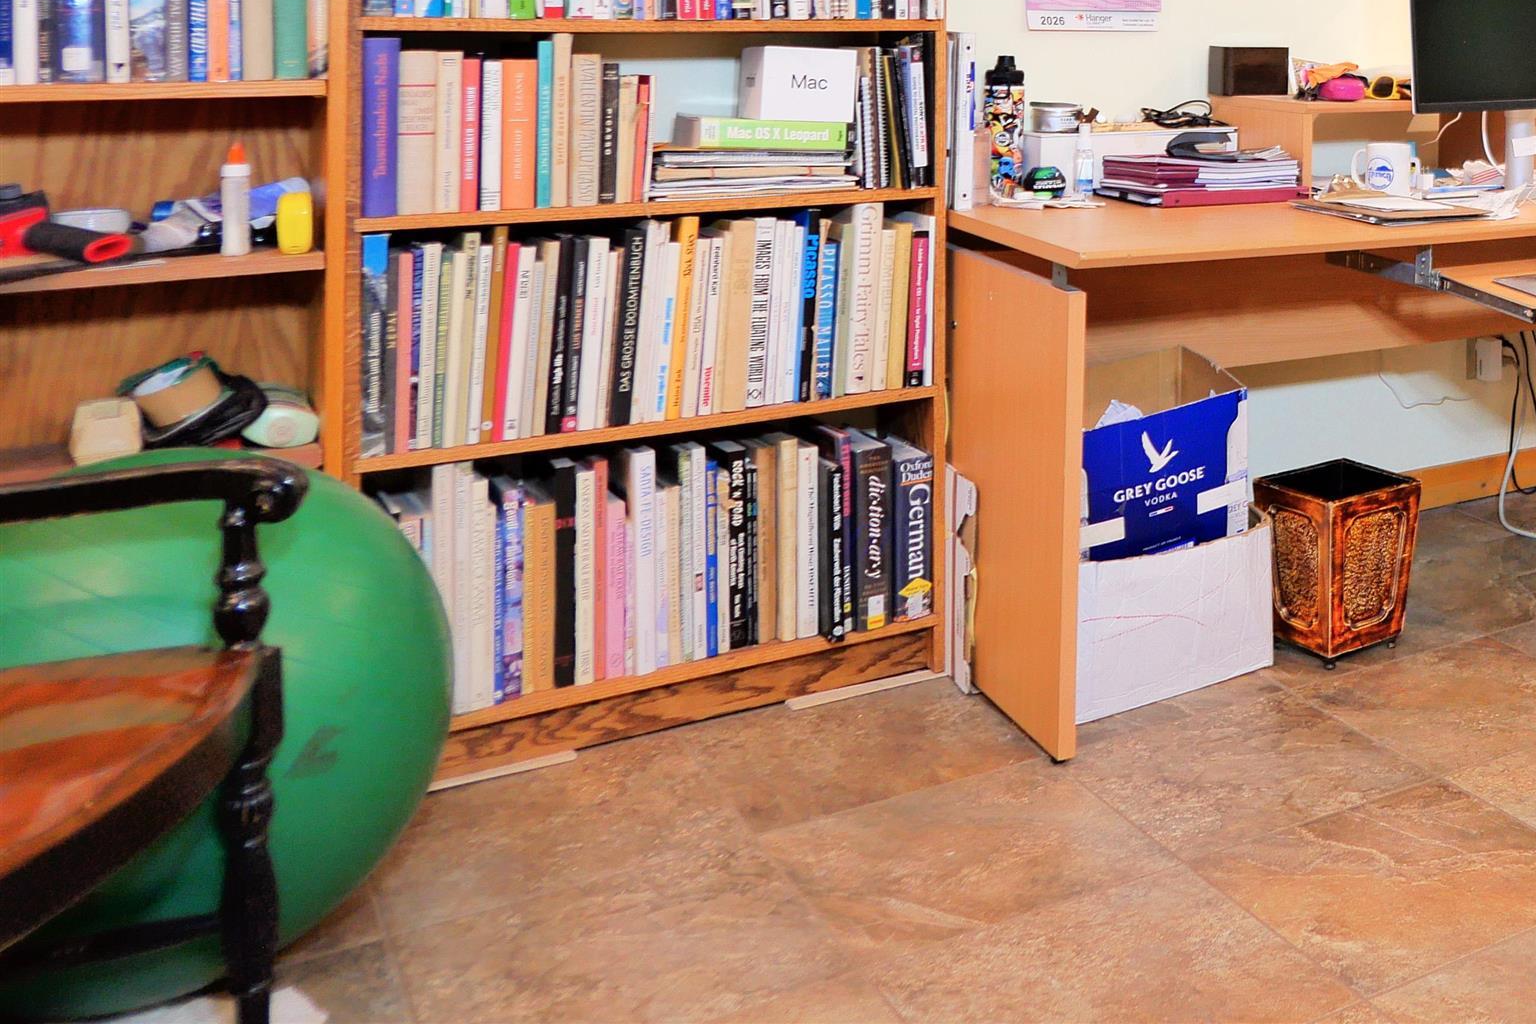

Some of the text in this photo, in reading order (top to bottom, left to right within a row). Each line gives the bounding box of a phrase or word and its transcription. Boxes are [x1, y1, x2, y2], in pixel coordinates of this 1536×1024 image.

[190, 1, 204, 26] THE
[1040, 16, 1065, 26] 2026
[1086, 14, 1112, 23] Hanger
[169, 22, 181, 77] HIMALAYA
[190, 28, 205, 53] VOID
[374, 52, 388, 84] Nacht
[790, 75, 828, 90] Mac
[604, 108, 613, 156] PICASSO
[727, 126, 830, 142] Mac OS X Leopard
[710, 246, 721, 296] Reinhard Karl
[852, 206, 878, 372] Grimm Fairy Tales
[619, 236, 643, 392] DAS GROSSE DOLOMITENBUCH
[750, 239, 772, 383] IMAGES FROM THE FLOATING WORLD
[816, 248, 834, 380] PICASSO MAILER
[388, 311, 398, 349] NEPAL
[703, 366, 712, 408] Yosemite
[640, 465, 650, 498] SANTA
[732, 460, 744, 486] ROCK
[900, 462, 933, 473] Oxford
[901, 472, 933, 483] Duden
[1113, 465, 1206, 504] GREY GOOSE
[1144, 492, 1178, 507] VODKA
[639, 520, 650, 558] DESIGN
[908, 483, 930, 580] German
[843, 566, 851, 603] DANIELS
